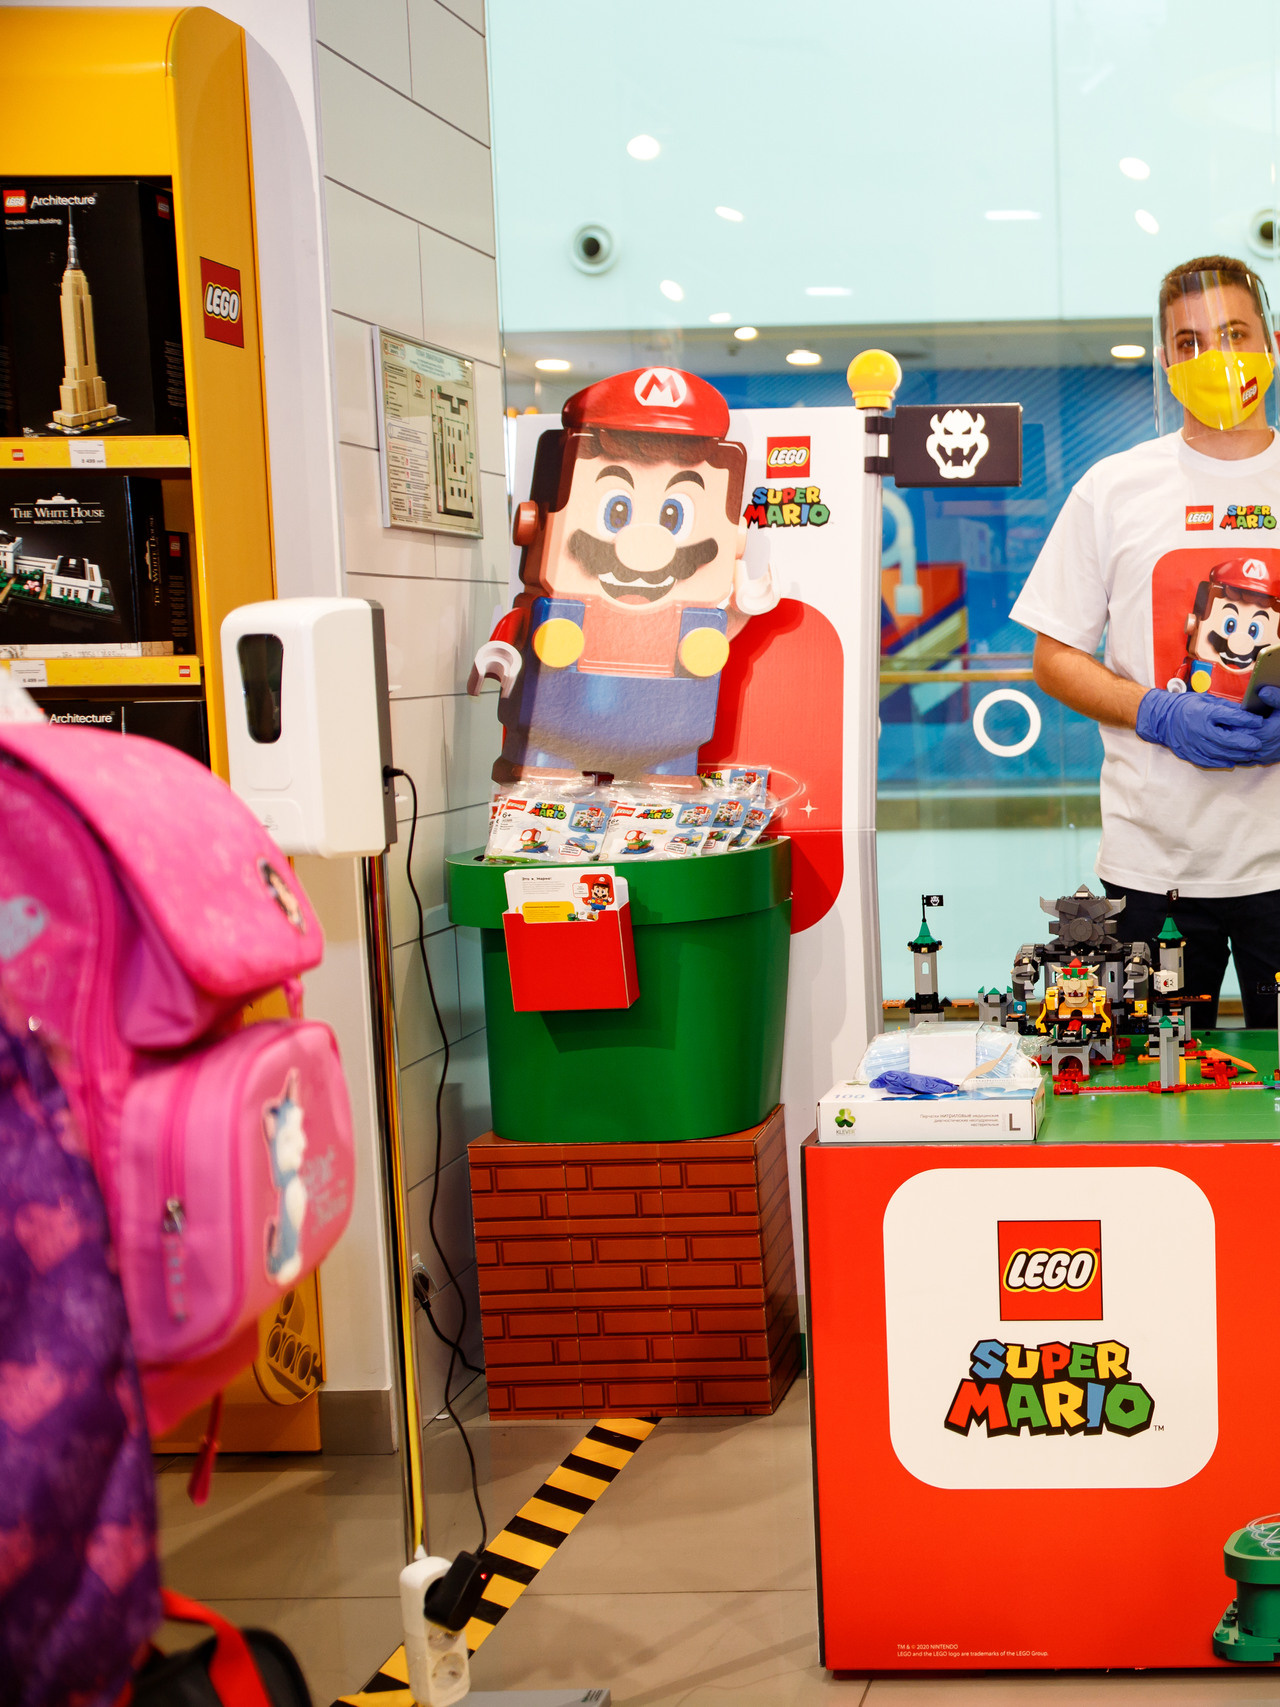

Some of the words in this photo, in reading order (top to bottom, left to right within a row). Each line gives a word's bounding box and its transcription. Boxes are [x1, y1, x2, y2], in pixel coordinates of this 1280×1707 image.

[31, 195, 96, 209] Architecture
[205, 282, 240, 323] LEGO
[1242, 384, 1257, 402] LEGO
[768, 447, 809, 467] LEGO
[752, 486, 821, 505] SUPER
[10, 507, 33, 518] THE
[34, 507, 68, 518] WHITE
[70, 507, 105, 518] HOUSE
[743, 503, 830, 529] MARIO
[1186, 512, 1213, 524] LEGO
[1227, 505, 1271, 516] SUPER
[1219, 514, 1277, 530] MARIO
[49, 713, 112, 725] Architecture
[528, 808, 567, 820] MARIO
[535, 802, 565, 812] SUPER
[1009, 1113, 1021, 1131] L
[1003, 1248, 1098, 1292] LEGO
[969, 1338, 1132, 1381] SUPER
[944, 1378, 1155, 1438] MARIO
